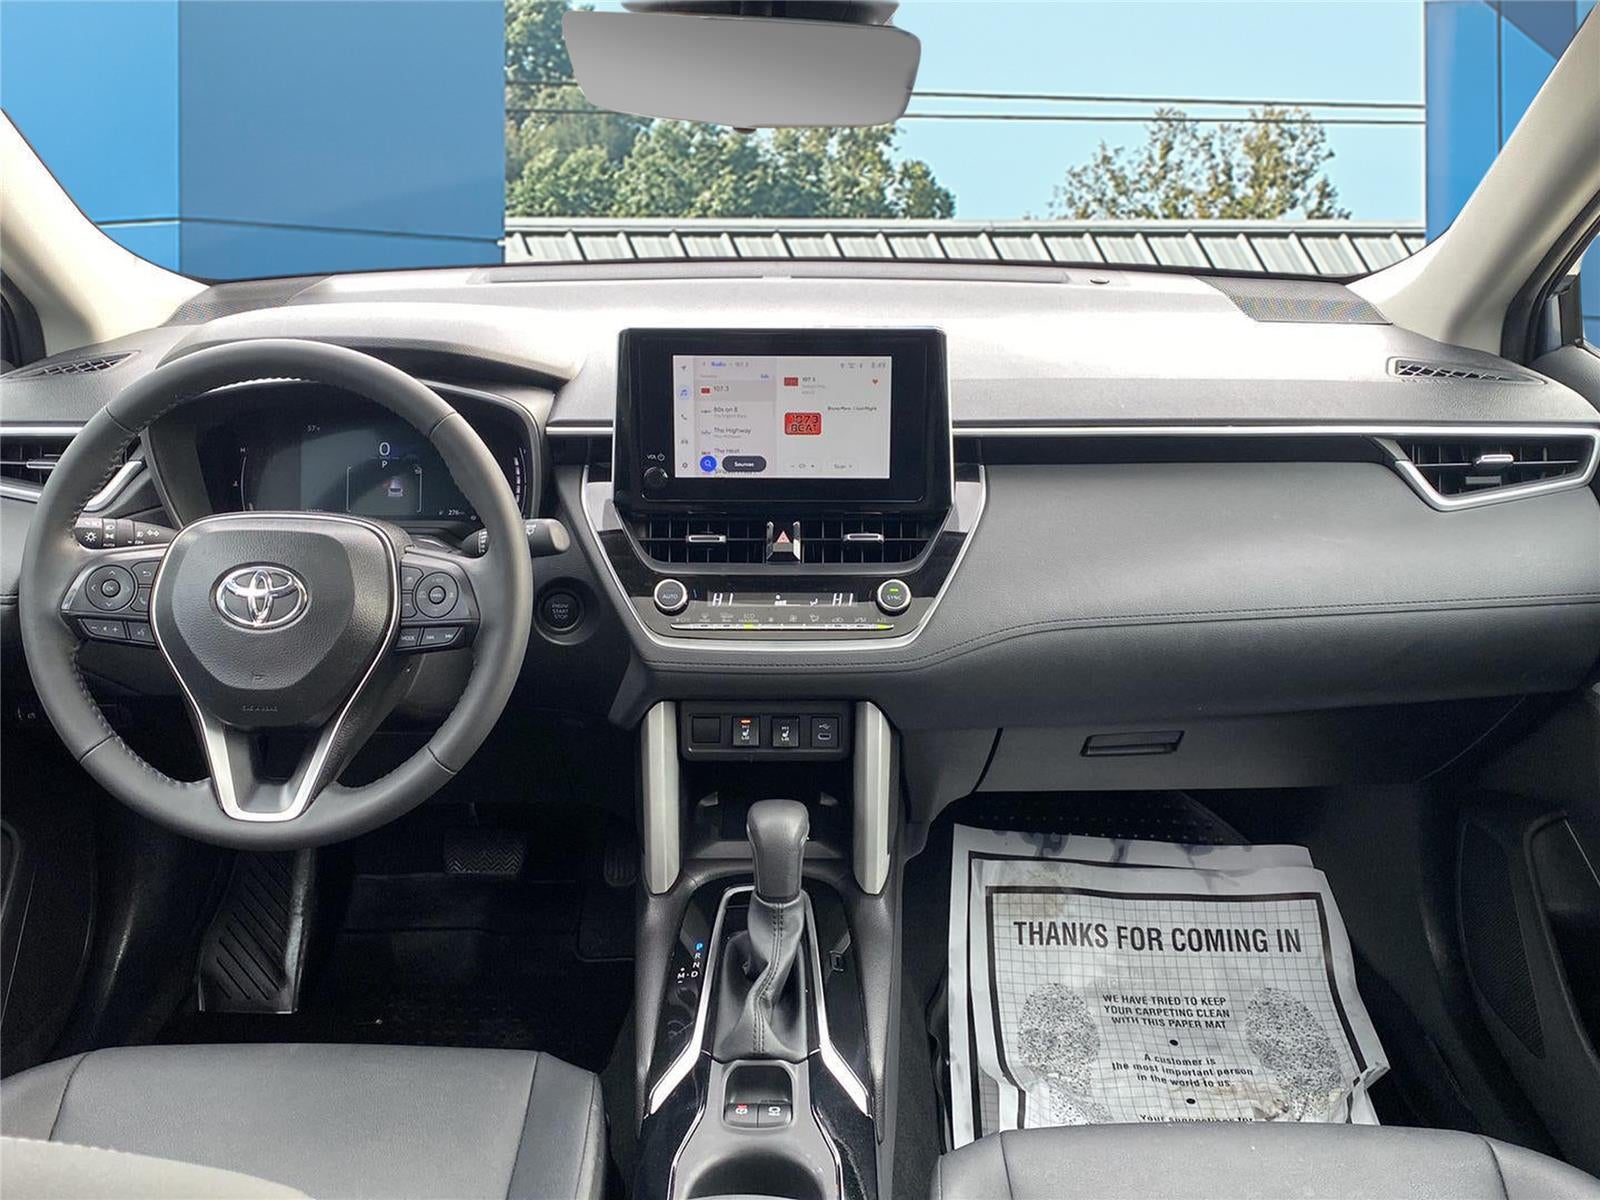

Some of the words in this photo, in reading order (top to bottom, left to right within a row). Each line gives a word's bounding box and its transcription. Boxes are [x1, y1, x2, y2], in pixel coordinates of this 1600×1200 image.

[726, 427, 752, 435] Highway
[381, 461, 388, 469] P
[1013, 921, 1109, 948] THANKS
[1116, 926, 1164, 951] FOR
[1171, 928, 1269, 953] COMING
[1276, 929, 1301, 953] IN
[1102, 994, 1119, 1003] WE
[1121, 995, 1149, 1005] HAVE
[1151, 996, 1181, 1006] TRIED
[1184, 996, 1198, 1006] TO
[1200, 997, 1227, 1006] KEEP
[1103, 1005, 1133, 1015] YOUR
[1135, 1006, 1194, 1017] CARPETING
[1196, 1009, 1230, 1018] CLEAN
[1111, 1016, 1140, 1024] WITH
[1142, 1018, 1166, 1027] THIS
[1168, 1019, 1202, 1029] PAPER
[1205, 1020, 1226, 1029] MAT
[1144, 1053, 1151, 1061] A
[1154, 1055, 1203, 1066] customer
[1206, 1057, 1217, 1066] is
[1111, 1062, 1129, 1071] the
[1132, 1063, 1159, 1073] most
[1161, 1066, 1214, 1078] important
[1216, 1069, 1254, 1077] person
[1136, 1073, 1147, 1081] in
[1150, 1074, 1168, 1084] the
[1169, 1079, 1200, 1088] world
[1203, 1077, 1214, 1088] to
